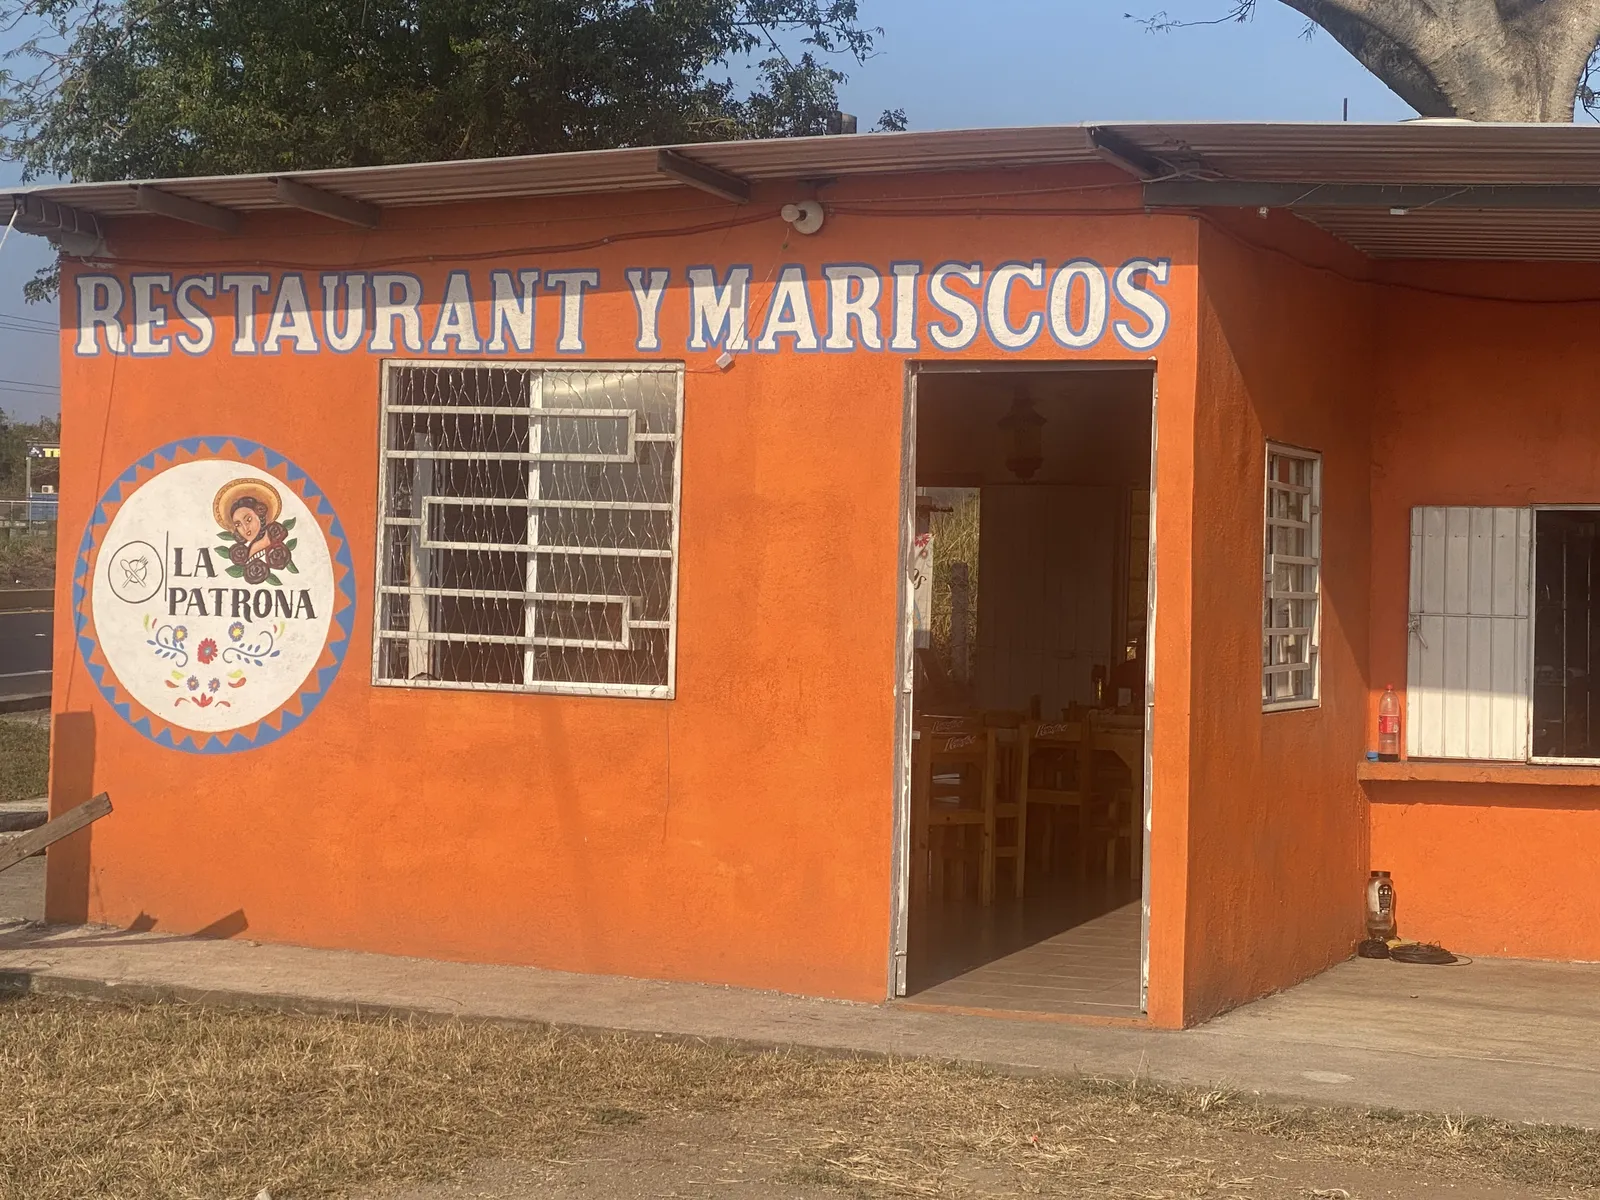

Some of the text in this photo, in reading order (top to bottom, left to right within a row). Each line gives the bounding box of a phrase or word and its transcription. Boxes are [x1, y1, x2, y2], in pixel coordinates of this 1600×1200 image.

[74, 257, 1171, 355] RESTAURANT Y MARISCOS
[173, 546, 217, 578] LA
[168, 587, 318, 623] PATRONA
